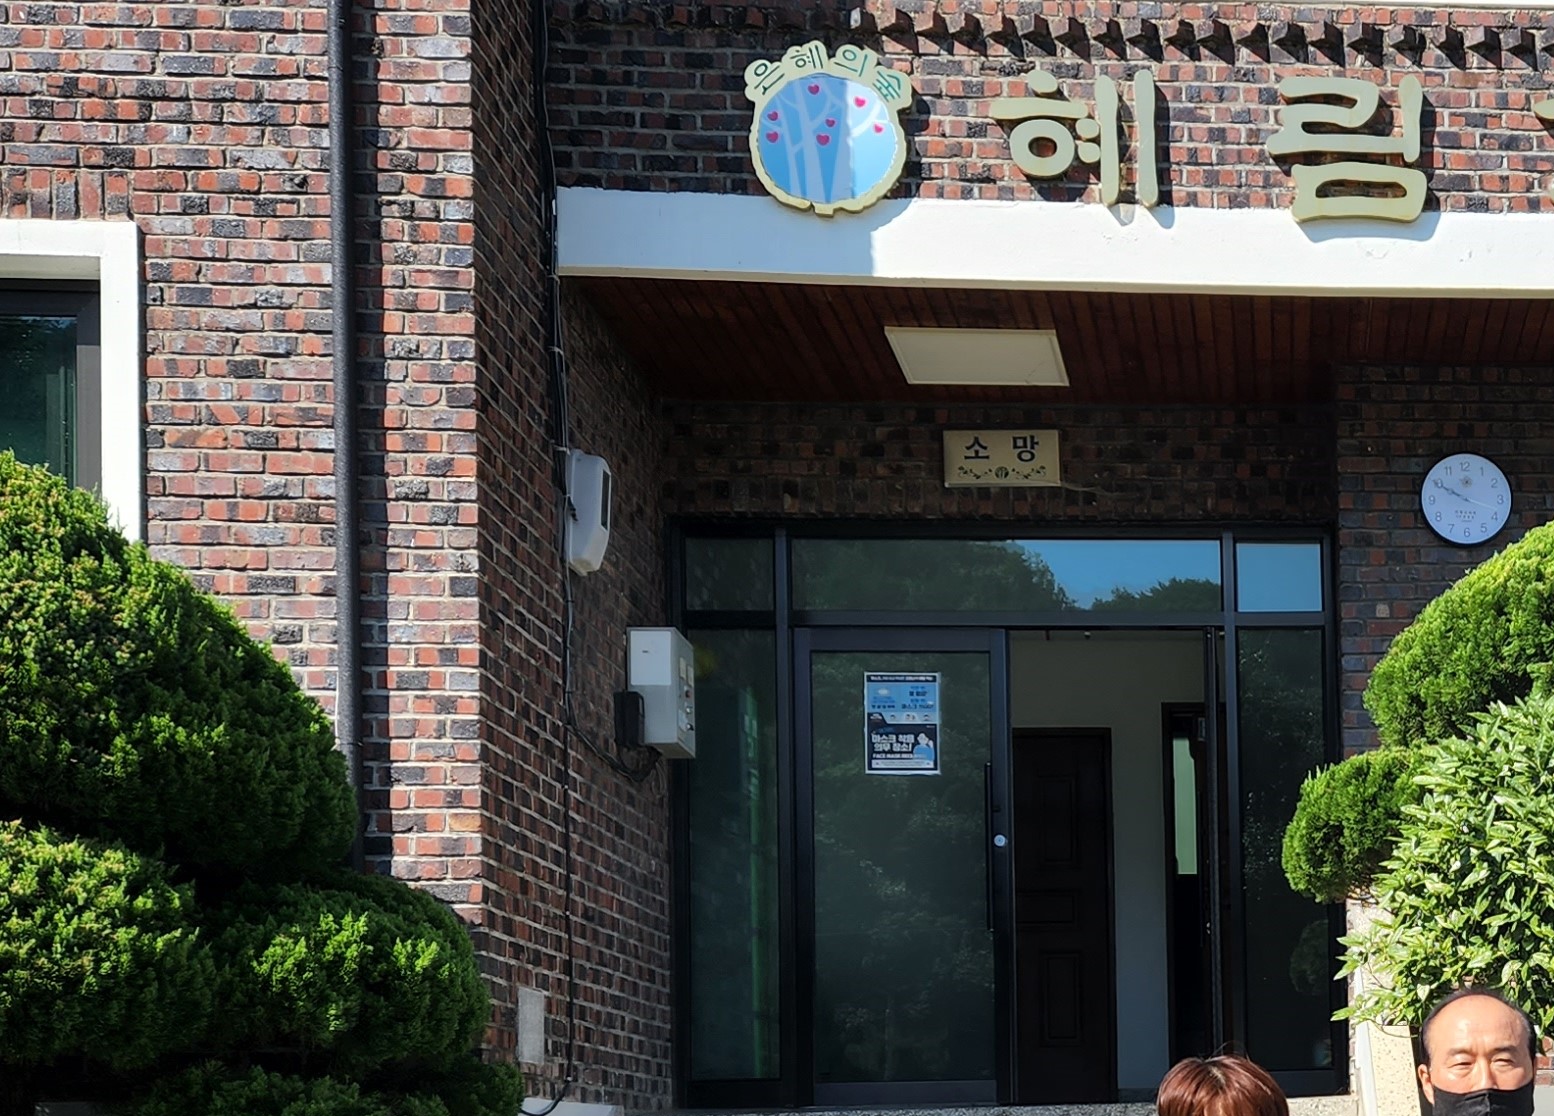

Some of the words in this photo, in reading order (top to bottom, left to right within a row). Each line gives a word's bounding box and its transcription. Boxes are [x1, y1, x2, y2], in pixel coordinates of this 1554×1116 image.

[1444, 466, 1452, 476] 11
[1460, 461, 1470, 472] 12
[1491, 478, 1498, 488] 2
[1428, 495, 1436, 505] 9
[1497, 494, 1504, 505] 3
[1435, 511, 1442, 522] 8
[1491, 511, 1498, 521] 4
[1448, 524, 1455, 533] 7
[1464, 527, 1470, 537] 6
[1480, 523, 1487, 533] 5
